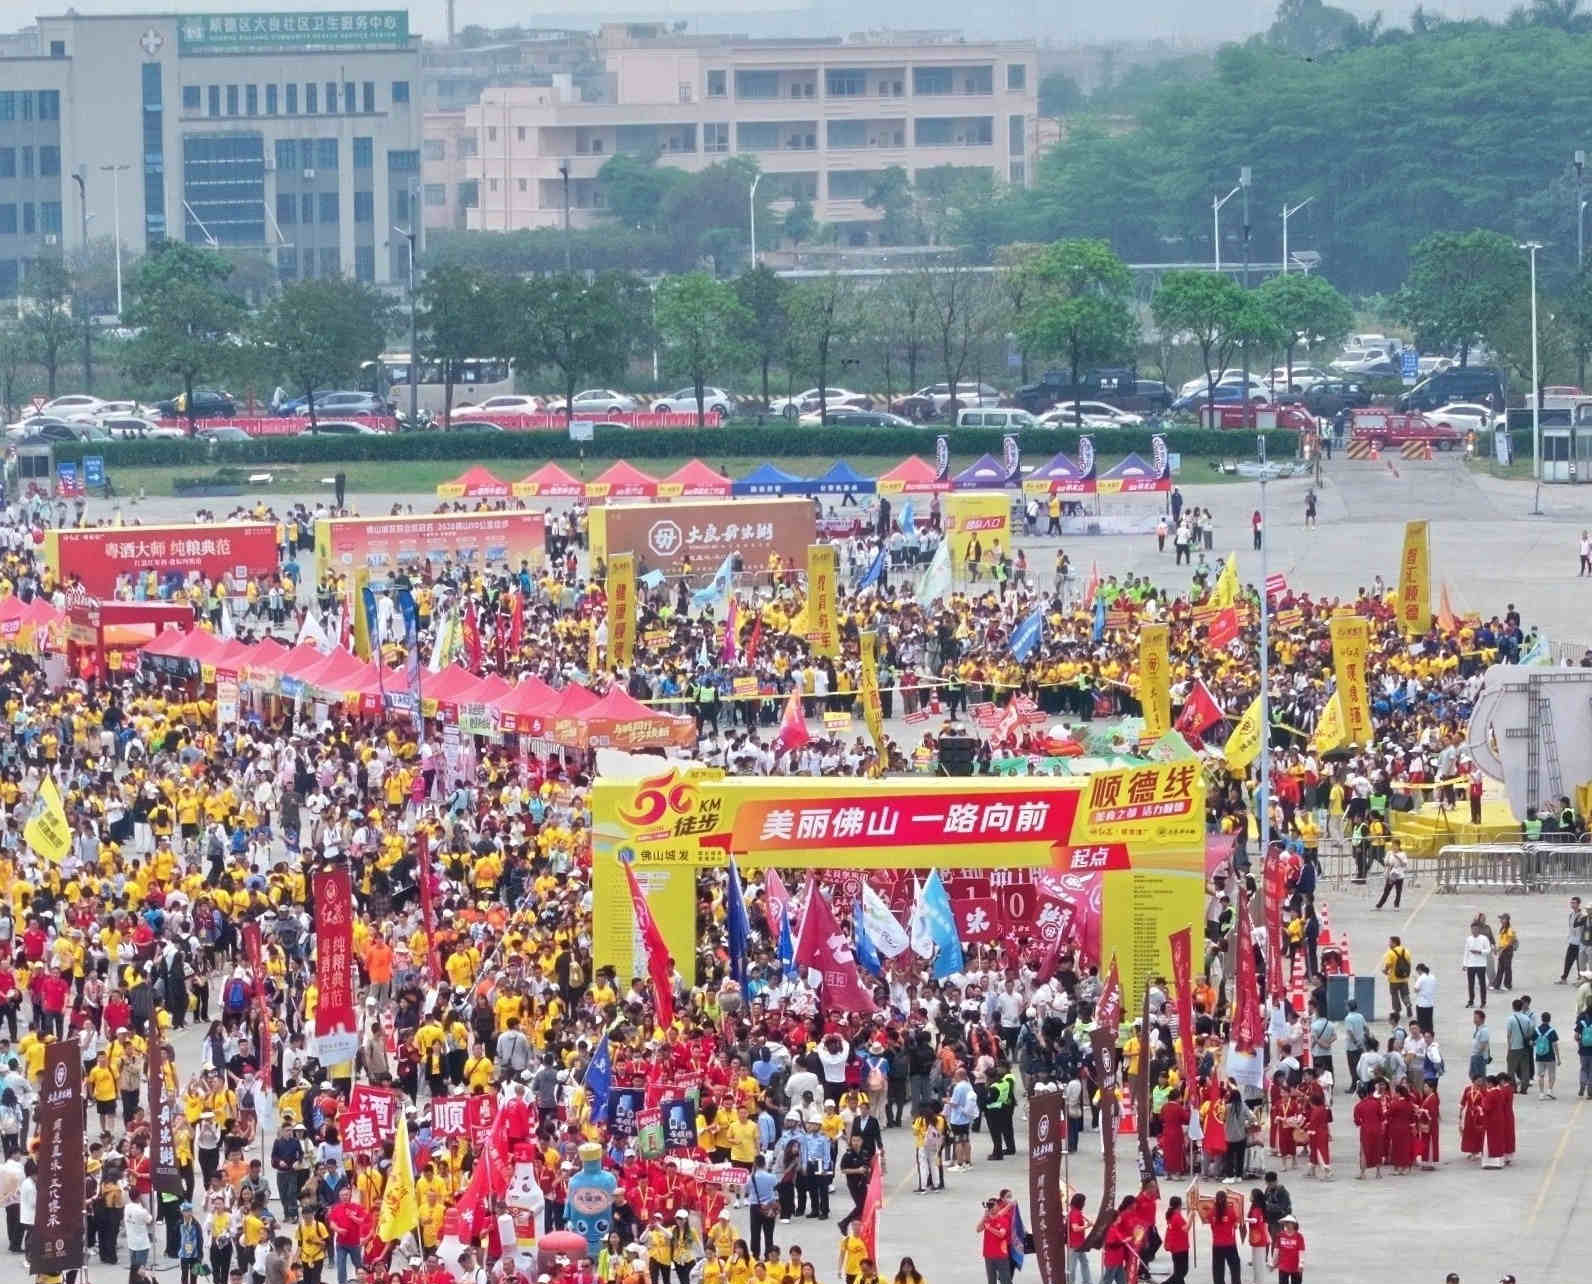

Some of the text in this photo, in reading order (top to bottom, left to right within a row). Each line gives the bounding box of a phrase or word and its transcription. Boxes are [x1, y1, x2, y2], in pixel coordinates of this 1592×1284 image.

[105, 538, 232, 559] 粤酒大师 纯粮典范
[618, 770, 699, 826] 50
[1089, 765, 1196, 809] 顺德线
[699, 797, 722, 813] KM
[674, 814, 720, 837] 徒步
[760, 801, 1050, 841] 美丽佛山 一路向前
[640, 849, 689, 862] 佛山城发
[1070, 847, 1110, 869] 起点
[966, 907, 991, 935] 味
[359, 1094, 391, 1126] 酒
[345, 1114, 377, 1149] 德
